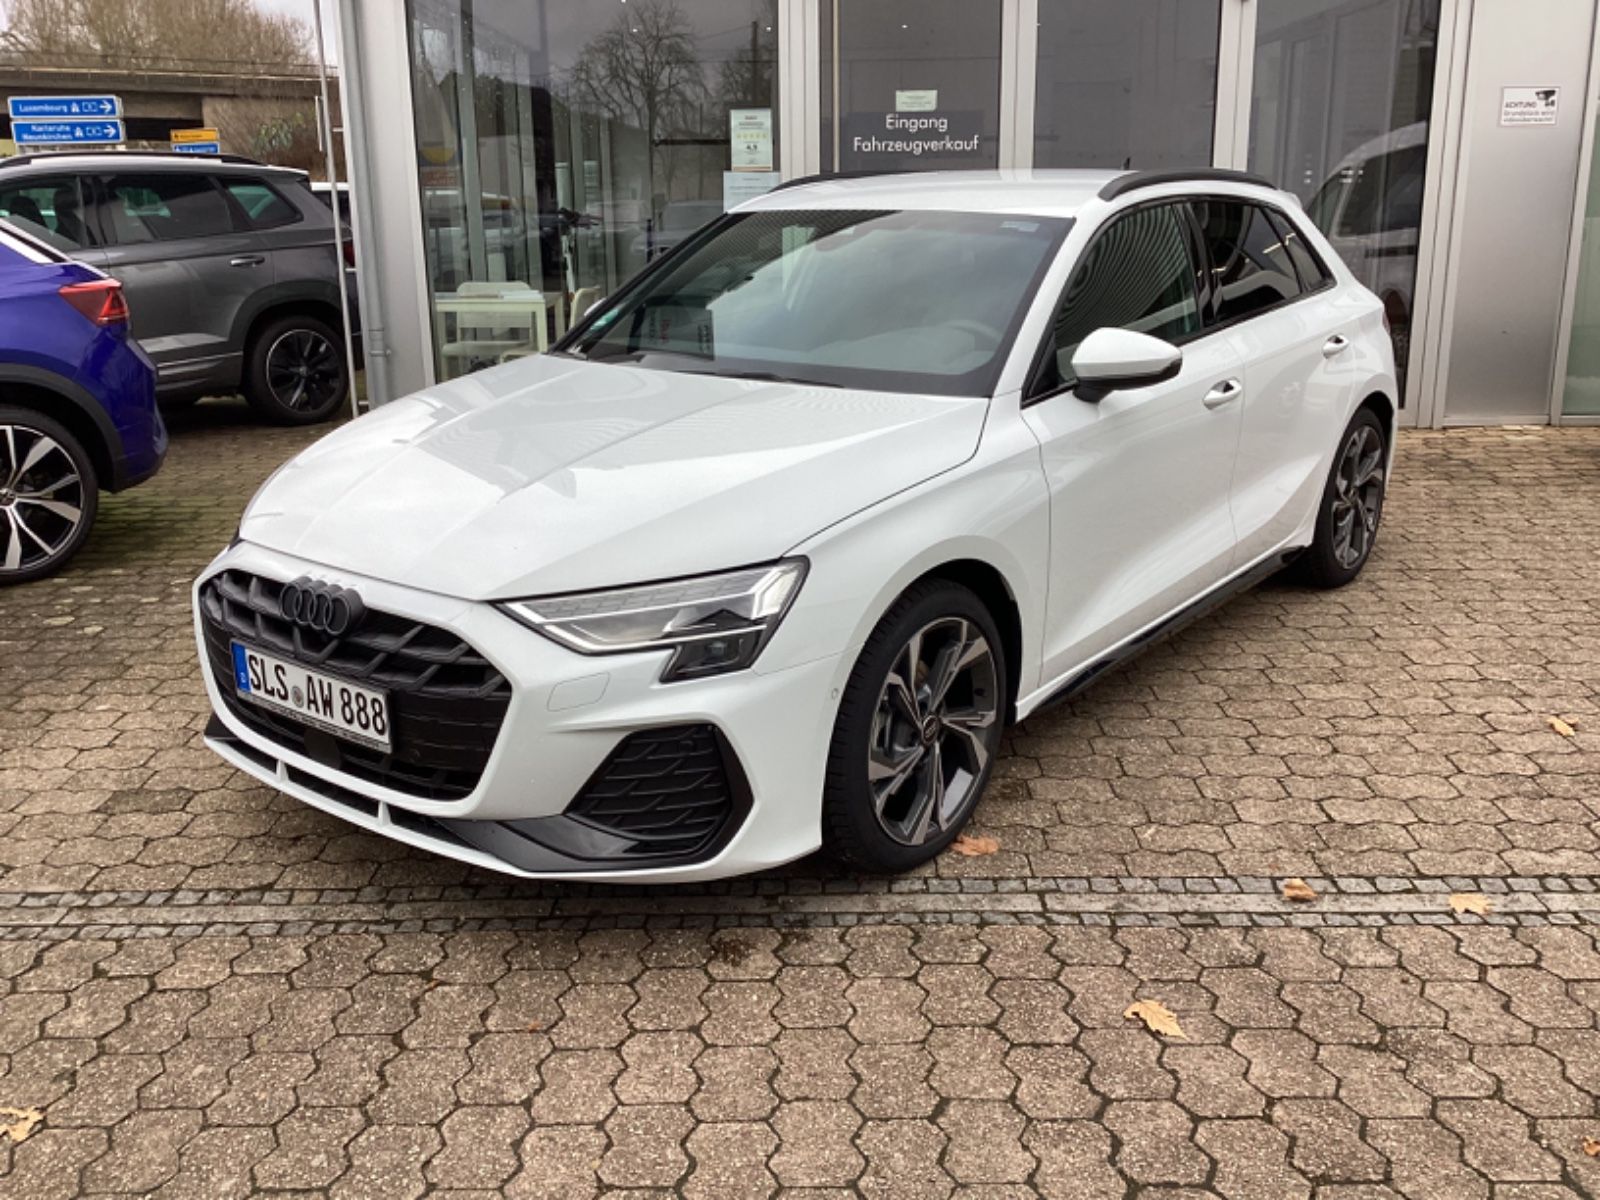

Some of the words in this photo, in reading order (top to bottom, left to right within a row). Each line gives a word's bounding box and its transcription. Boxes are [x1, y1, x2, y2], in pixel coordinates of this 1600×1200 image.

[18, 104, 67, 113] Luxembourg
[885, 113, 949, 133] Eingang
[853, 135, 980, 155] Fahrzeugverkauf
[248, 654, 289, 701] SLS
[306, 674, 334, 719] AW
[340, 687, 386, 736] 888
